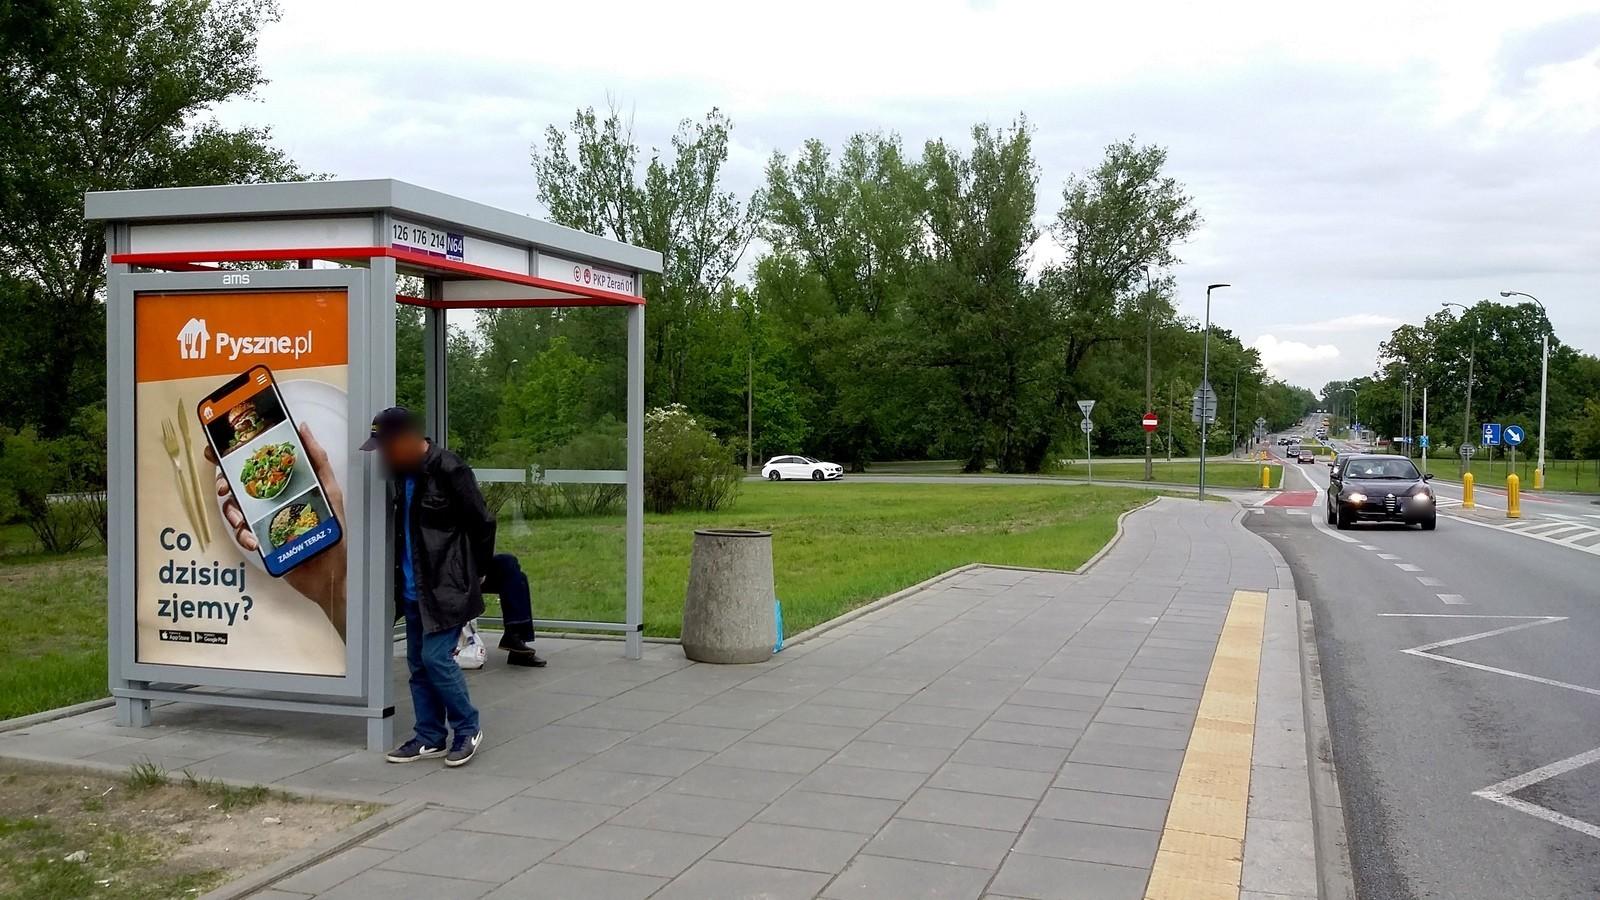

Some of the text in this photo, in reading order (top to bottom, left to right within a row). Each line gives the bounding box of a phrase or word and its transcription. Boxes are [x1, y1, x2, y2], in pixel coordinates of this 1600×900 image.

[393, 224, 463, 253] 126 176 214 N64
[223, 274, 250, 285] ams
[593, 273, 633, 293] PKP Żerań 01
[216, 330, 312, 361] Pyszne.pl
[160, 527, 192, 551] Co
[277, 530, 327, 563] ZAMÓW TERAZ
[158, 559, 245, 593] dzisiaj
[157, 592, 253, 626] zjemy?
